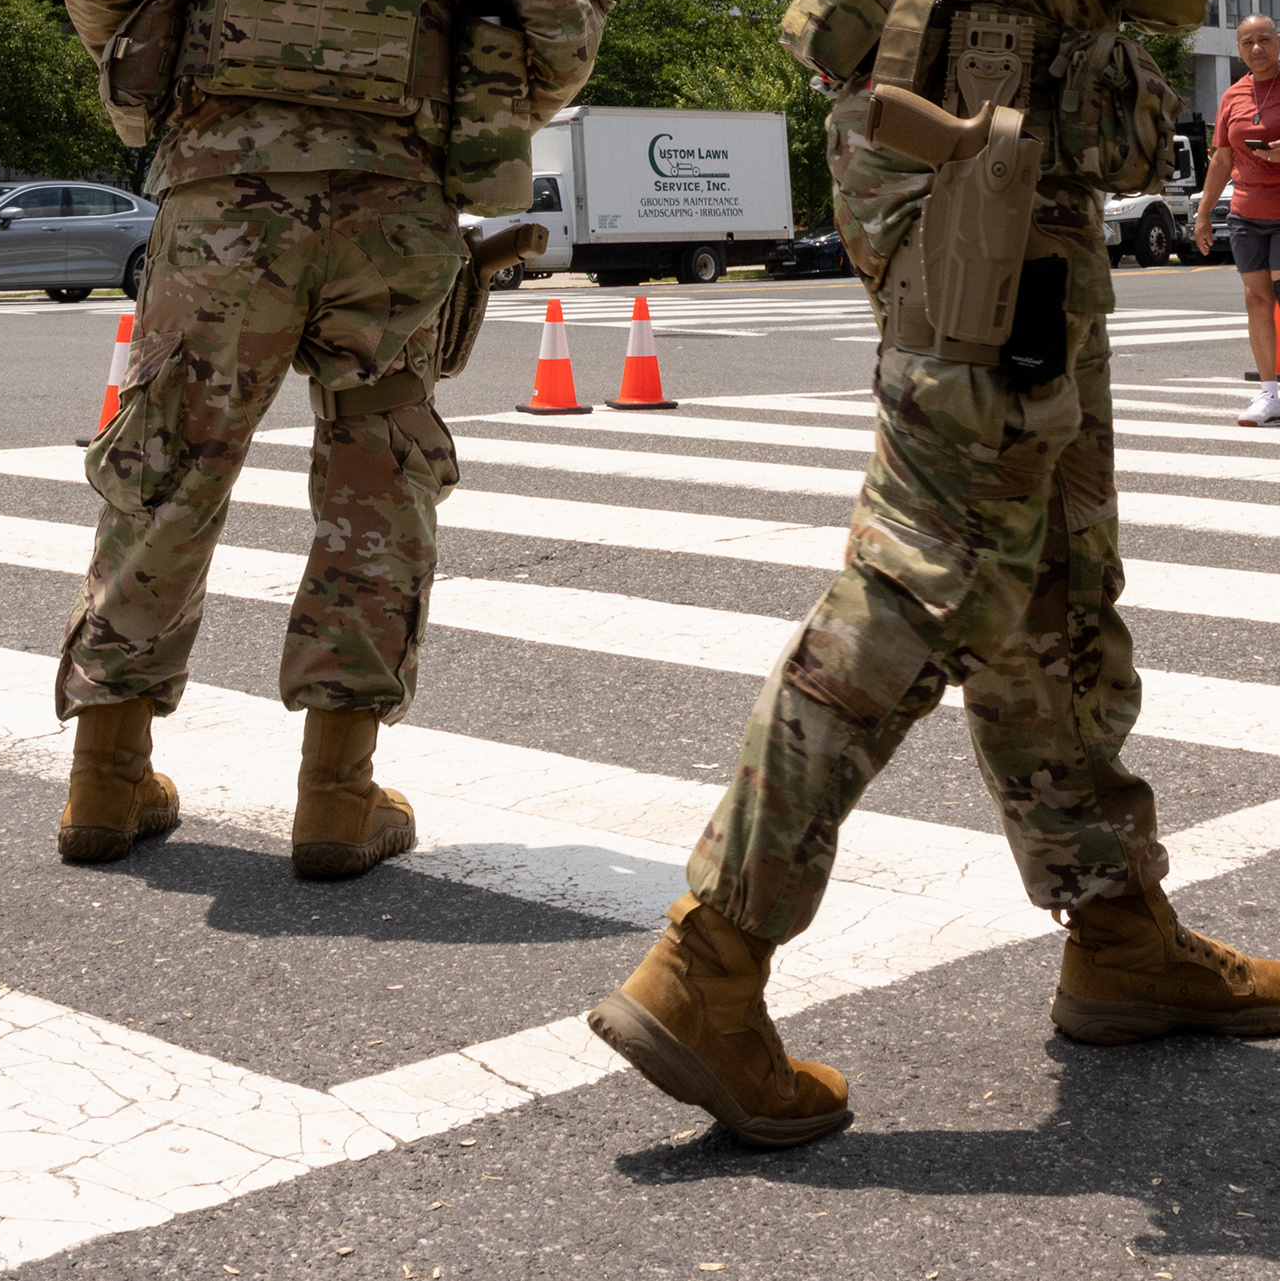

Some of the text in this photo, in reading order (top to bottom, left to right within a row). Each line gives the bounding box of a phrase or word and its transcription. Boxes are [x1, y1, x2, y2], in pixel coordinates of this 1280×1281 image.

[698, 148, 728, 159] LAWN
[654, 180, 730, 193] SERVICE, INC.
[640, 197, 739, 206] GROUNDS MAINTENANCE
[638, 208, 693, 218] LANDSCAPING
[700, 207, 743, 217] IRRIGATION
